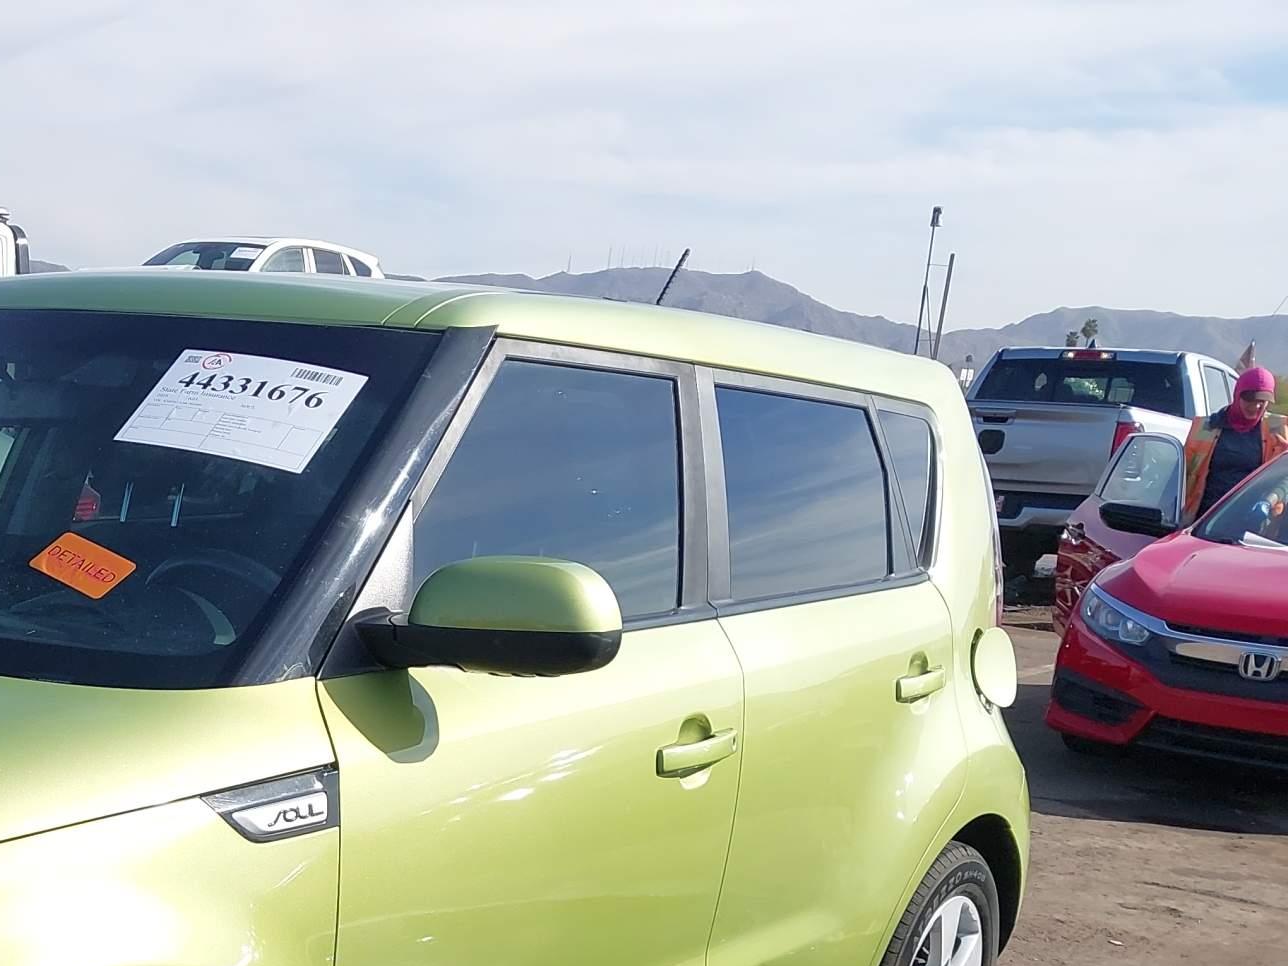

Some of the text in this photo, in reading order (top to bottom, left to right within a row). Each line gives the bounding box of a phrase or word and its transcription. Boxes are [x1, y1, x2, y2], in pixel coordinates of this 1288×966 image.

[179, 371, 329, 409] 44331676
[47, 545, 116, 583] DETAILED
[267, 803, 324, 828] SOUL
